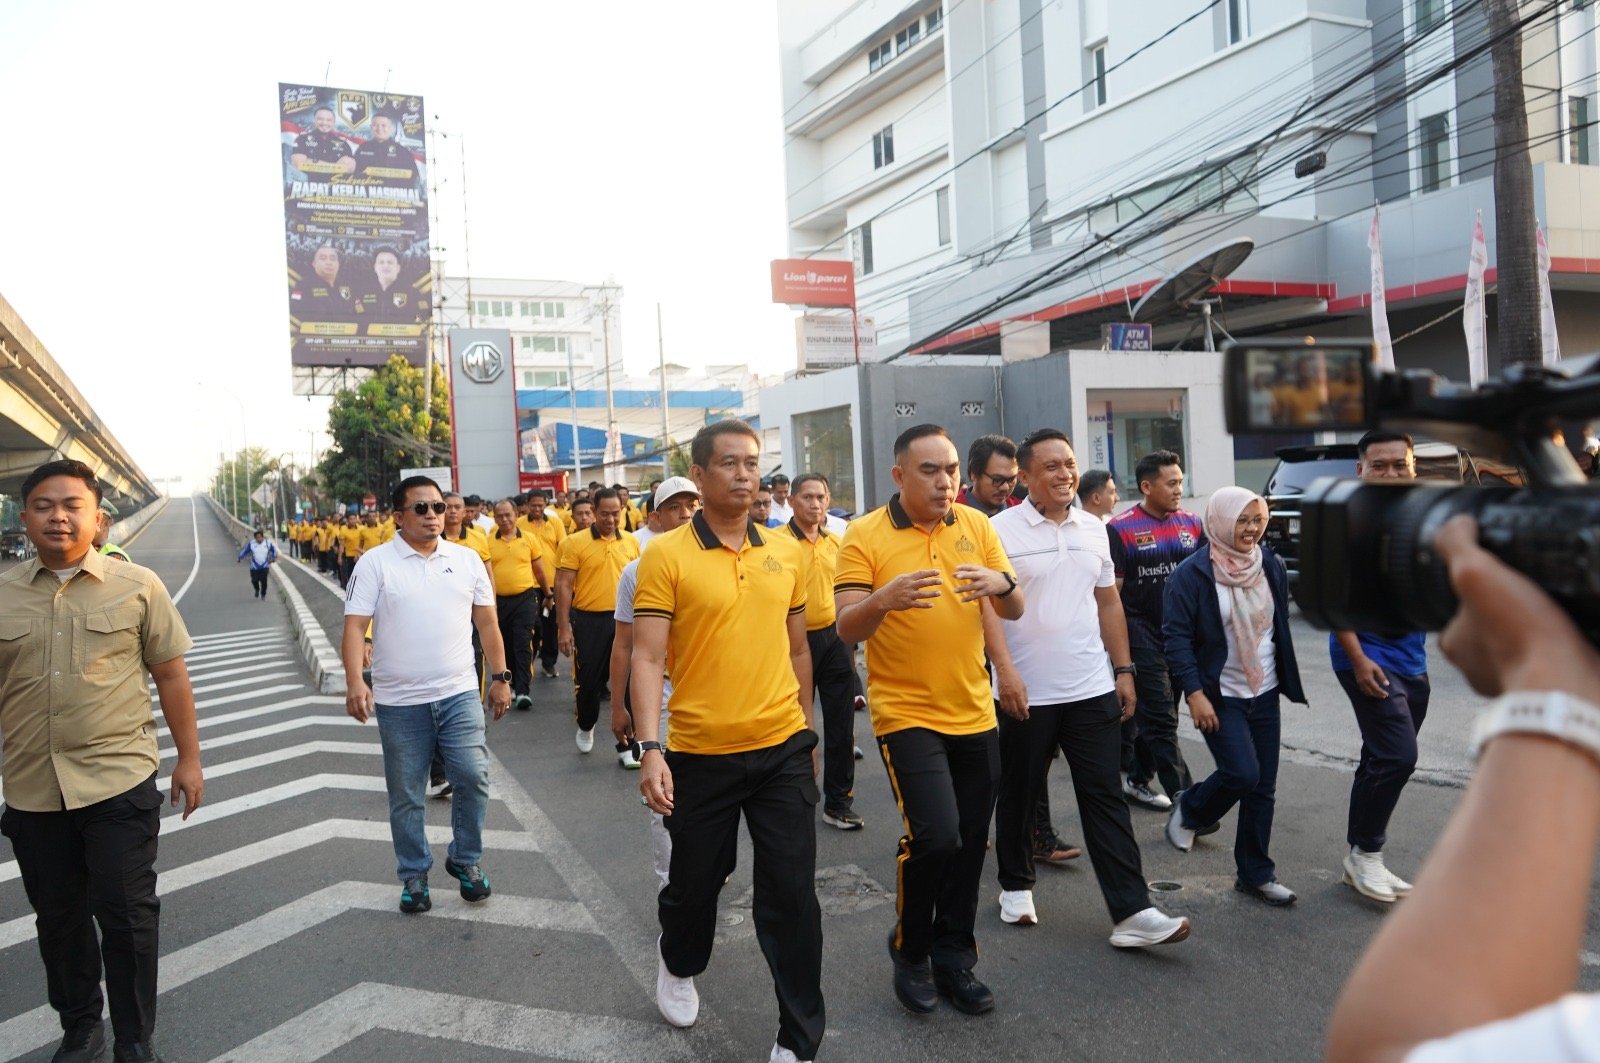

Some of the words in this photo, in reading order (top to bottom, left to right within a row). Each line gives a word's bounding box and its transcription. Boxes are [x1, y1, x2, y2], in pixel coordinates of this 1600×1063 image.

[291, 181, 329, 198] RAPAT
[332, 184, 368, 199] KERJA
[368, 187, 420, 204] NASIONAL
[783, 272, 806, 282] Lion
[816, 275, 848, 284] parcel
[1126, 329, 1145, 339] ATM
[1132, 340, 1150, 350] BCA
[466, 344, 501, 379] MG
[1093, 435, 1104, 465] tarik
